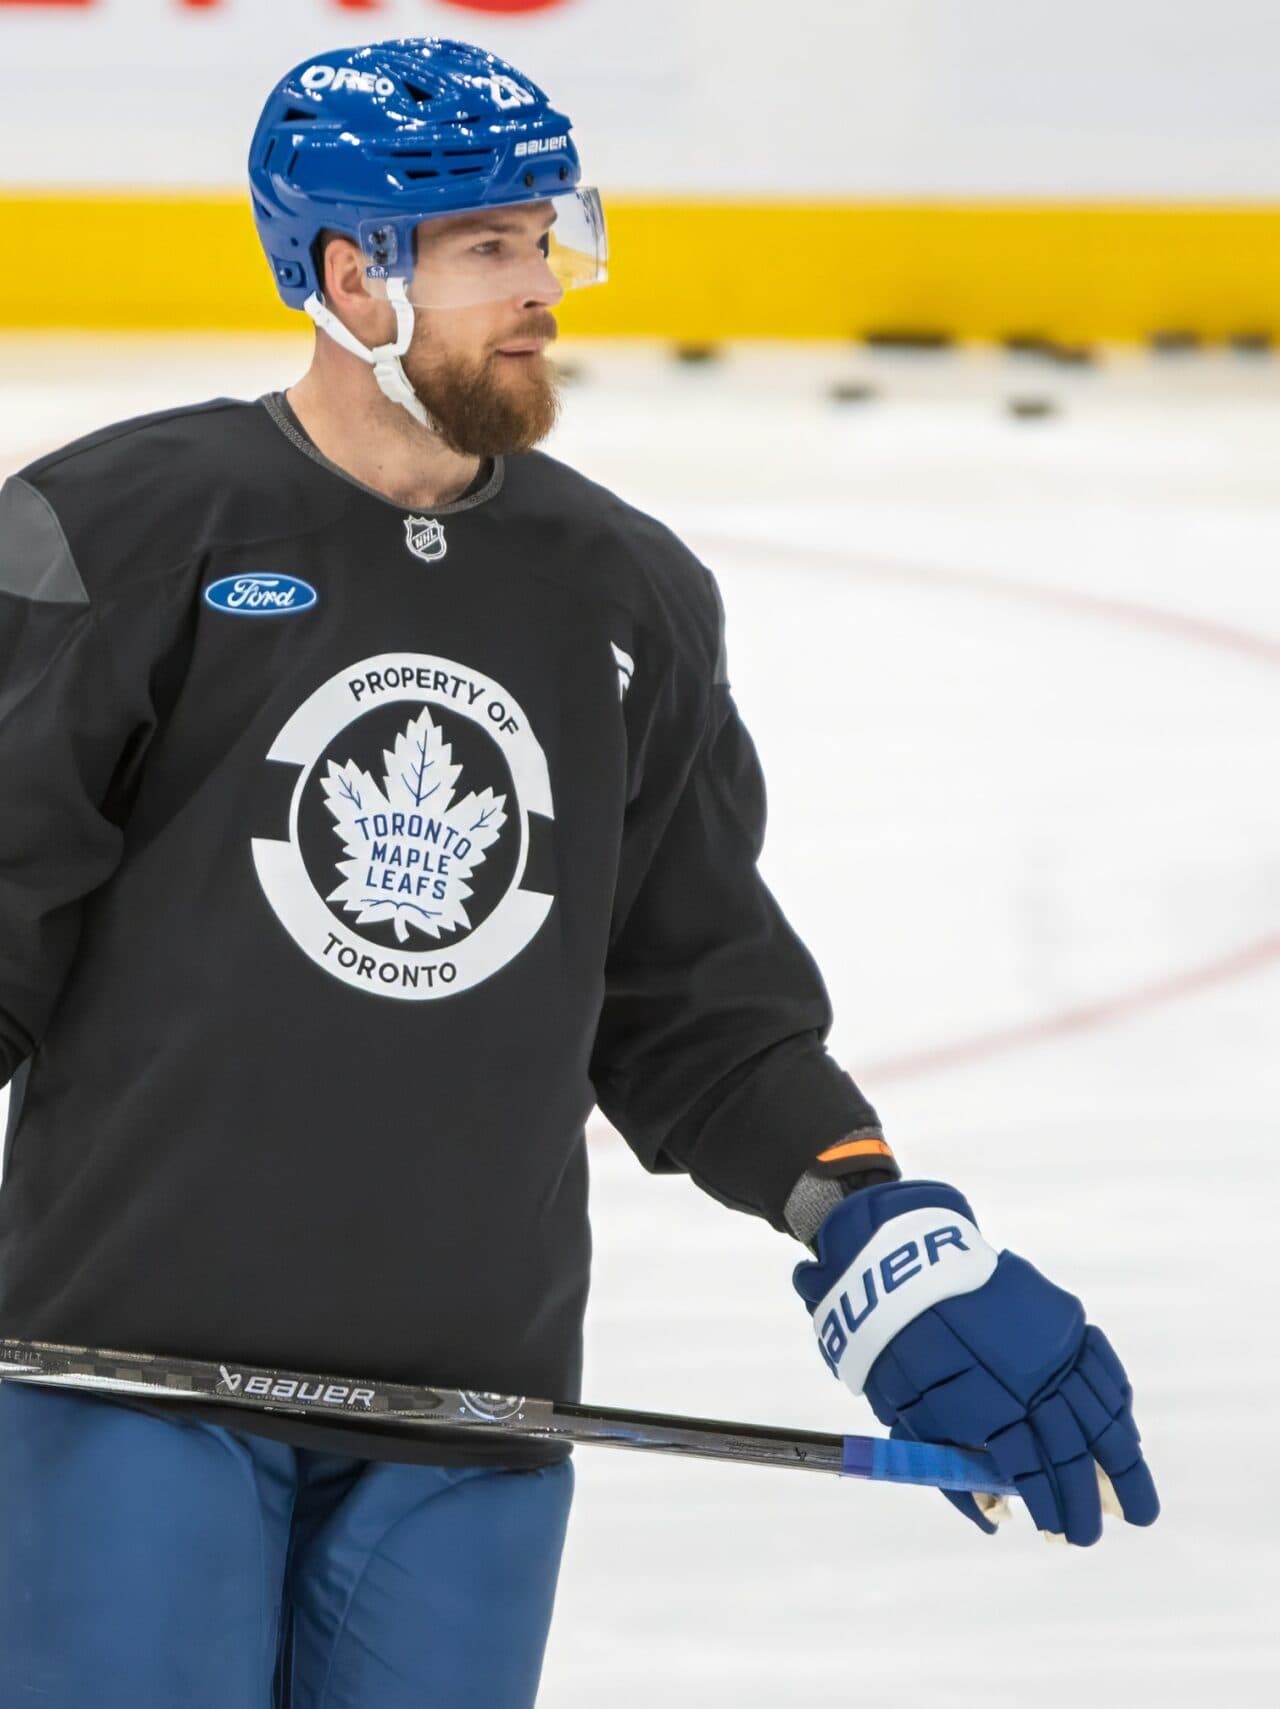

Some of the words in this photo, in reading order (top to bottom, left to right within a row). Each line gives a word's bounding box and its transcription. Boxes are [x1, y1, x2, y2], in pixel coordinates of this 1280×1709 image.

[300, 65, 395, 96] OREO
[514, 135, 568, 157] BAUER
[414, 528, 438, 549] NHL
[227, 578, 296, 607] Ford
[348, 667, 485, 705] PROPERTY
[487, 701, 519, 735] OF
[354, 812, 471, 860] TORONTO
[371, 841, 451, 875] MAPLE
[365, 866, 447, 900] LEAFS
[323, 932, 456, 987] TORONTO
[818, 1225, 971, 1380] AUER
[244, 1376, 375, 1407] BAUER
